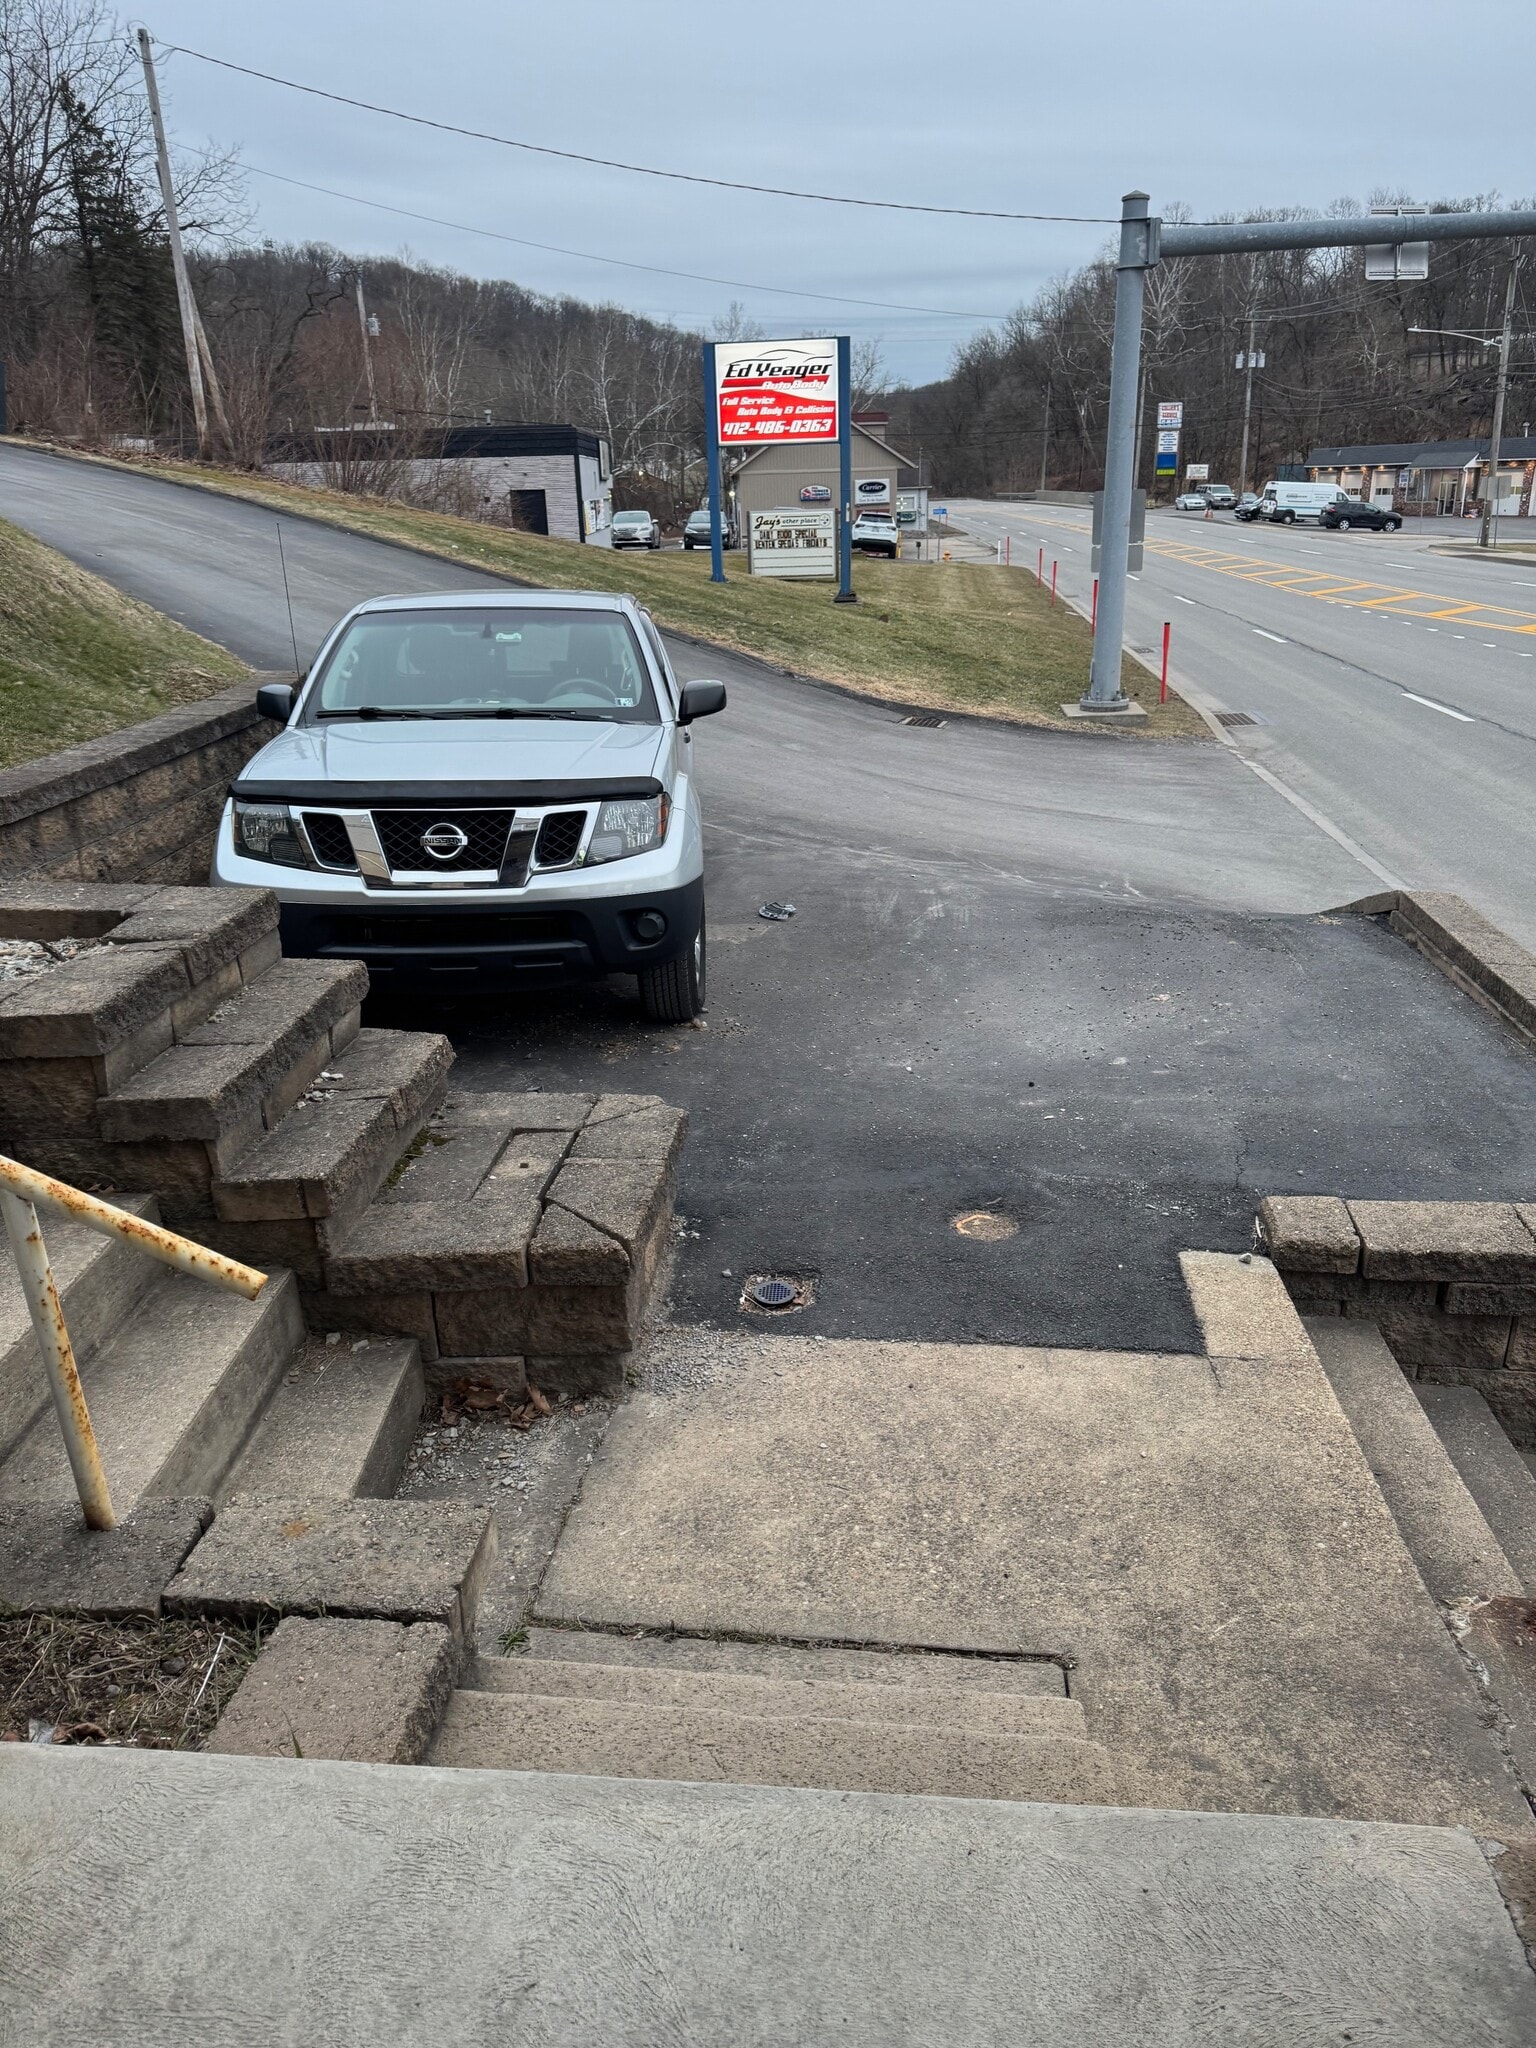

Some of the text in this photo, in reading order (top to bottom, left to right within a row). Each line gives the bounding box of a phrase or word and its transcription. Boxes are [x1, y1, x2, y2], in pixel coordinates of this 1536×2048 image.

[725, 362, 833, 379] Ed Yeager
[792, 379, 825, 391] Body
[721, 396, 776, 406] Full Service
[736, 405, 835, 416] Auto Body & Collision
[722, 419, 833, 435] 412-486-0363
[861, 483, 884, 491] Carrier
[754, 515, 781, 529] Jay's
